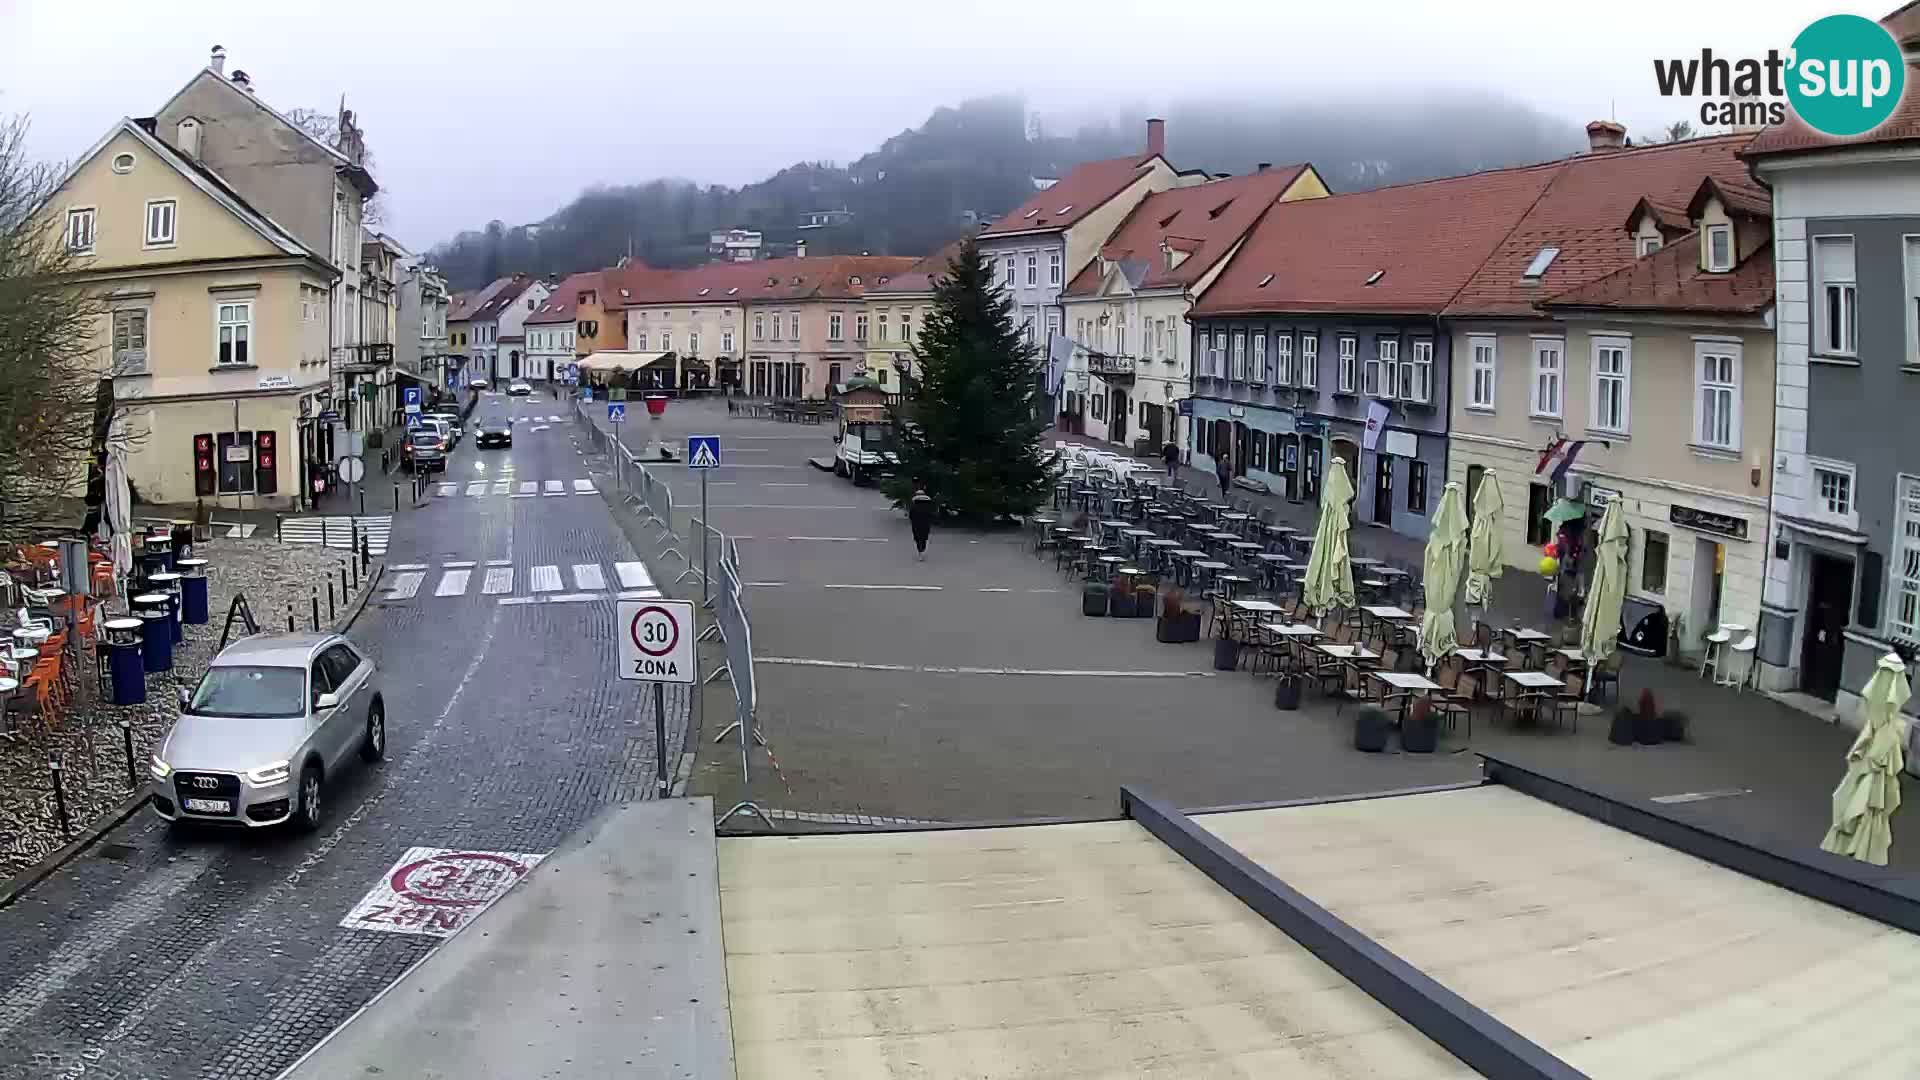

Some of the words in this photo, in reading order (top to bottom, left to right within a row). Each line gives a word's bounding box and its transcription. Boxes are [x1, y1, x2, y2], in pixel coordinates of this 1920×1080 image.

[643, 622, 667, 642] 30
[634, 660, 678, 676] ZONA
[360, 905, 462, 929] ZON
